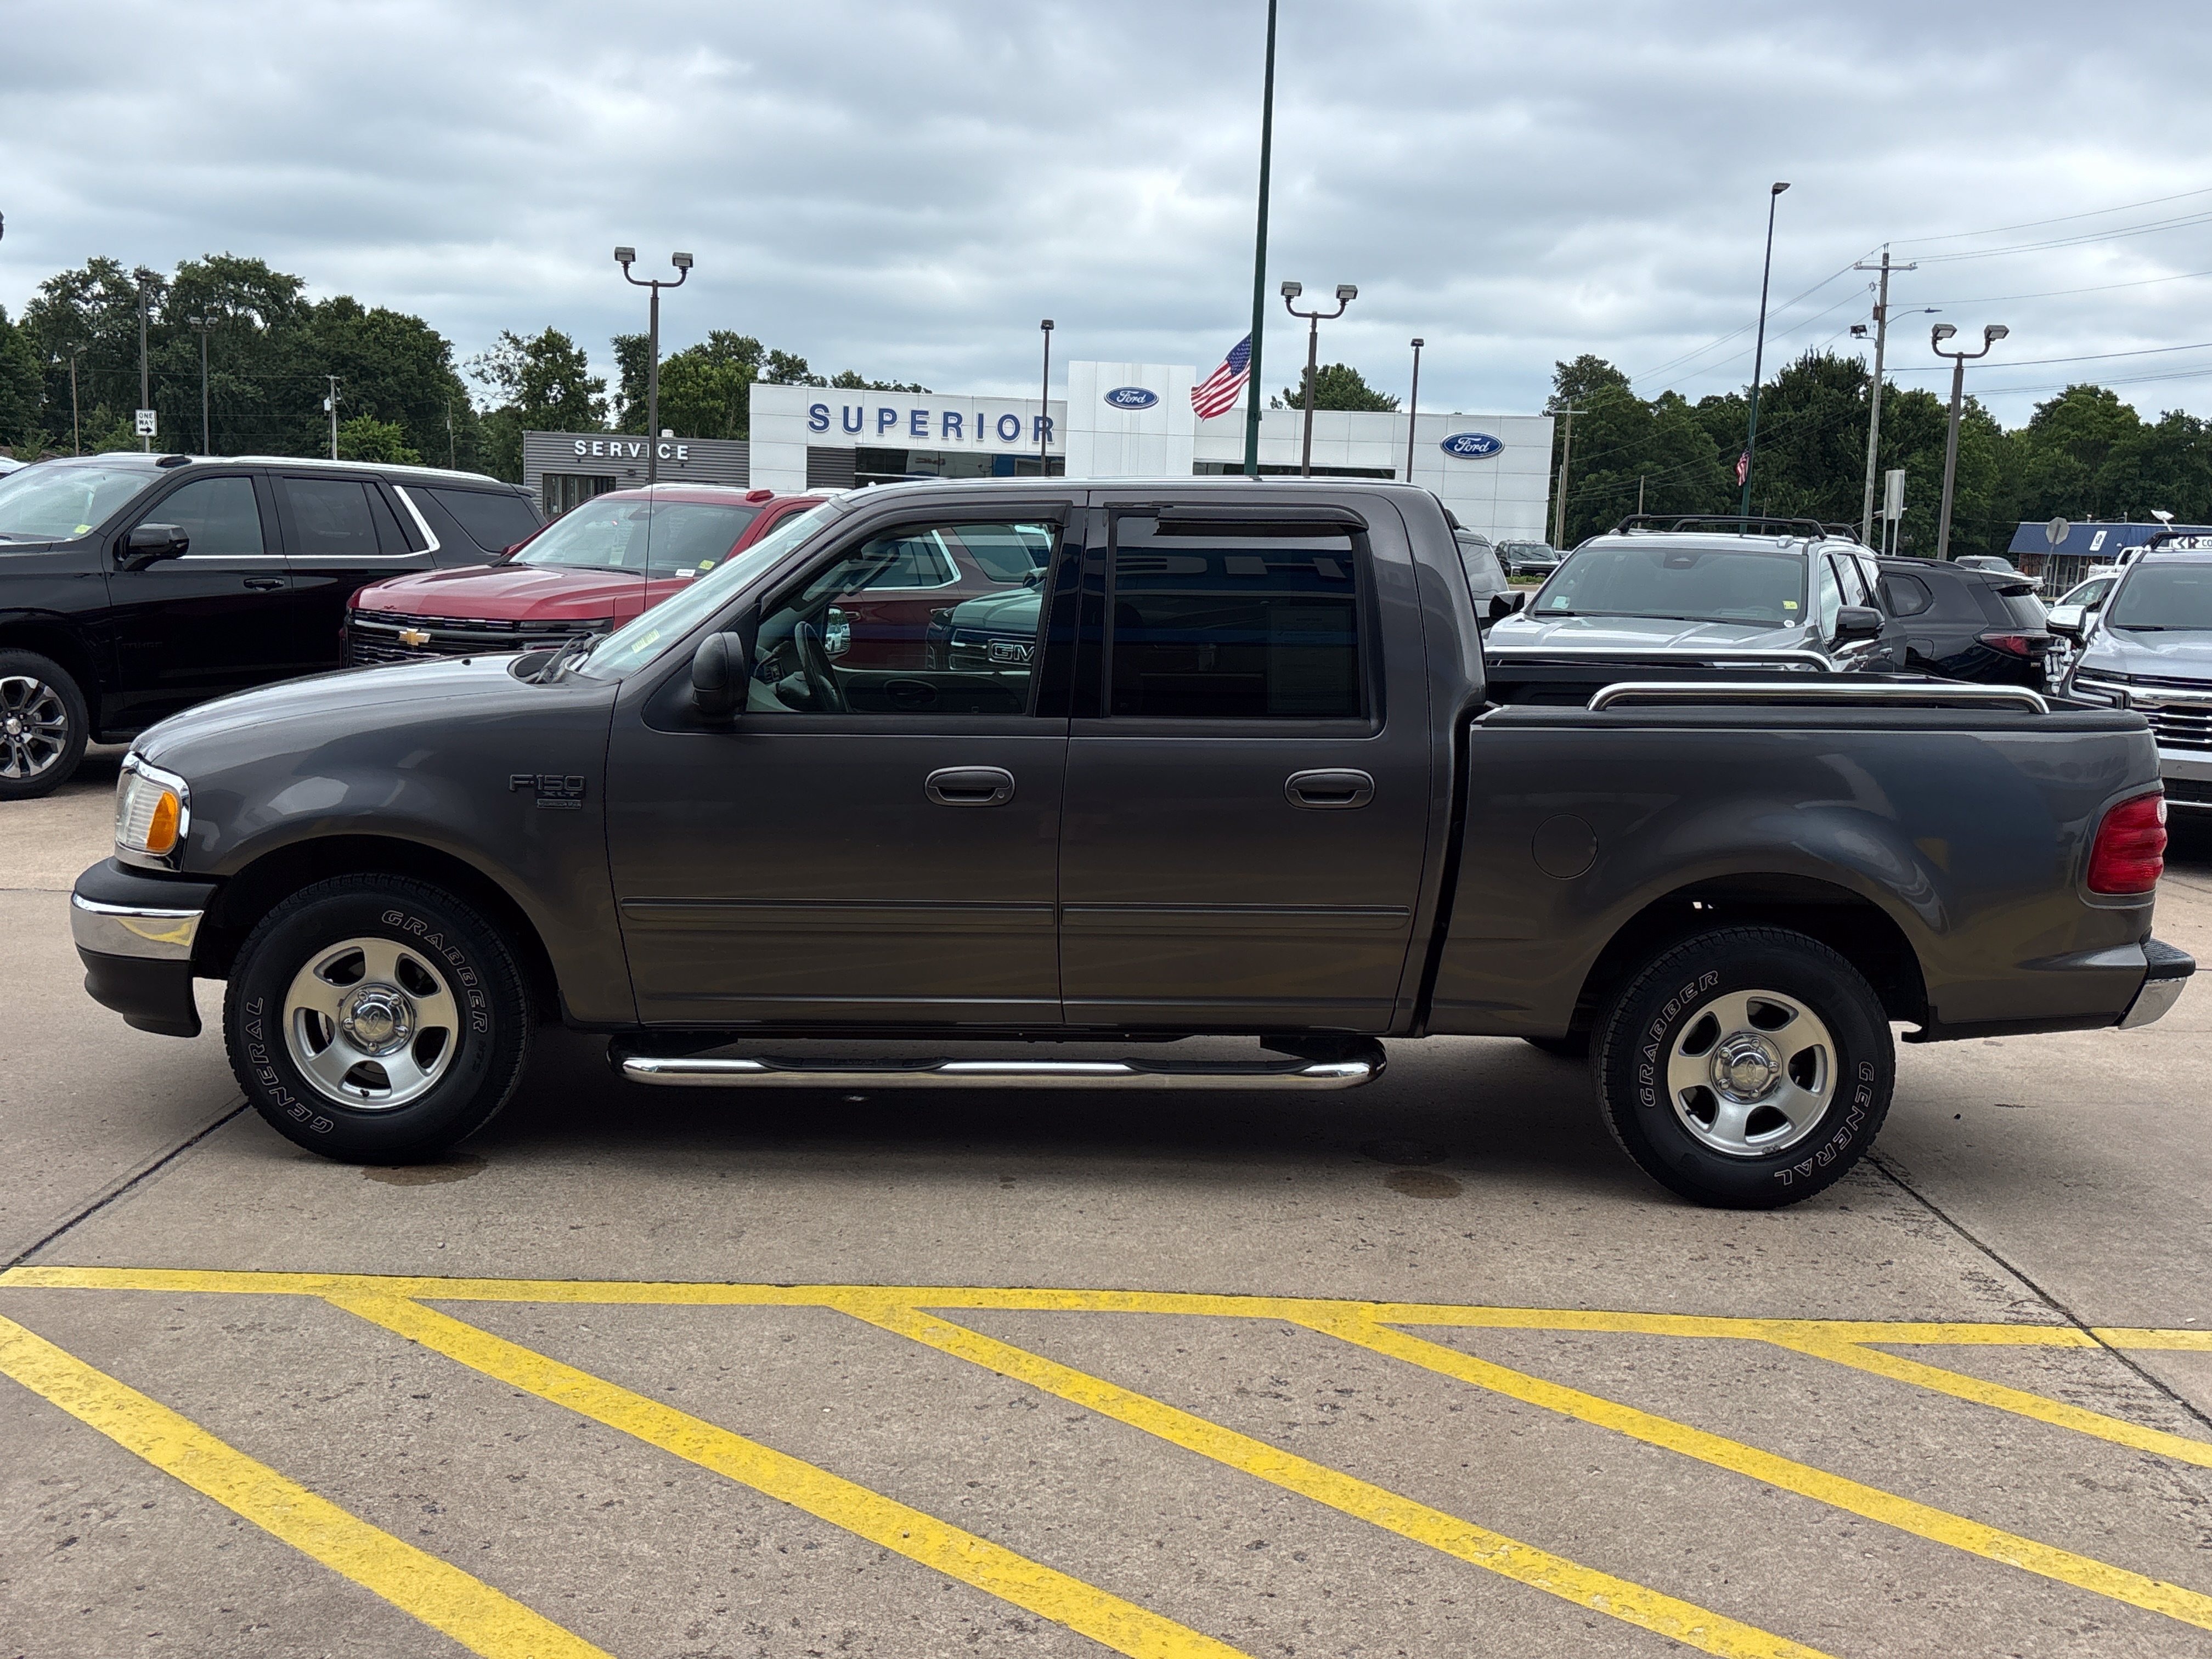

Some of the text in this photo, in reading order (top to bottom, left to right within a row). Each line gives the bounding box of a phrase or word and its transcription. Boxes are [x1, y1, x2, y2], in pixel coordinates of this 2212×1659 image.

[808, 403, 1054, 443] SUPERIOR
[1116, 390, 1147, 403] Ford
[574, 440, 689, 460] SERVICE
[1454, 437, 1491, 452] Ford
[381, 909, 488, 1034] GRABBER
[245, 997, 334, 1135] GENERAL
[1638, 970, 1719, 1108] GRABBER
[1774, 1062, 1874, 1186] GENERAL
